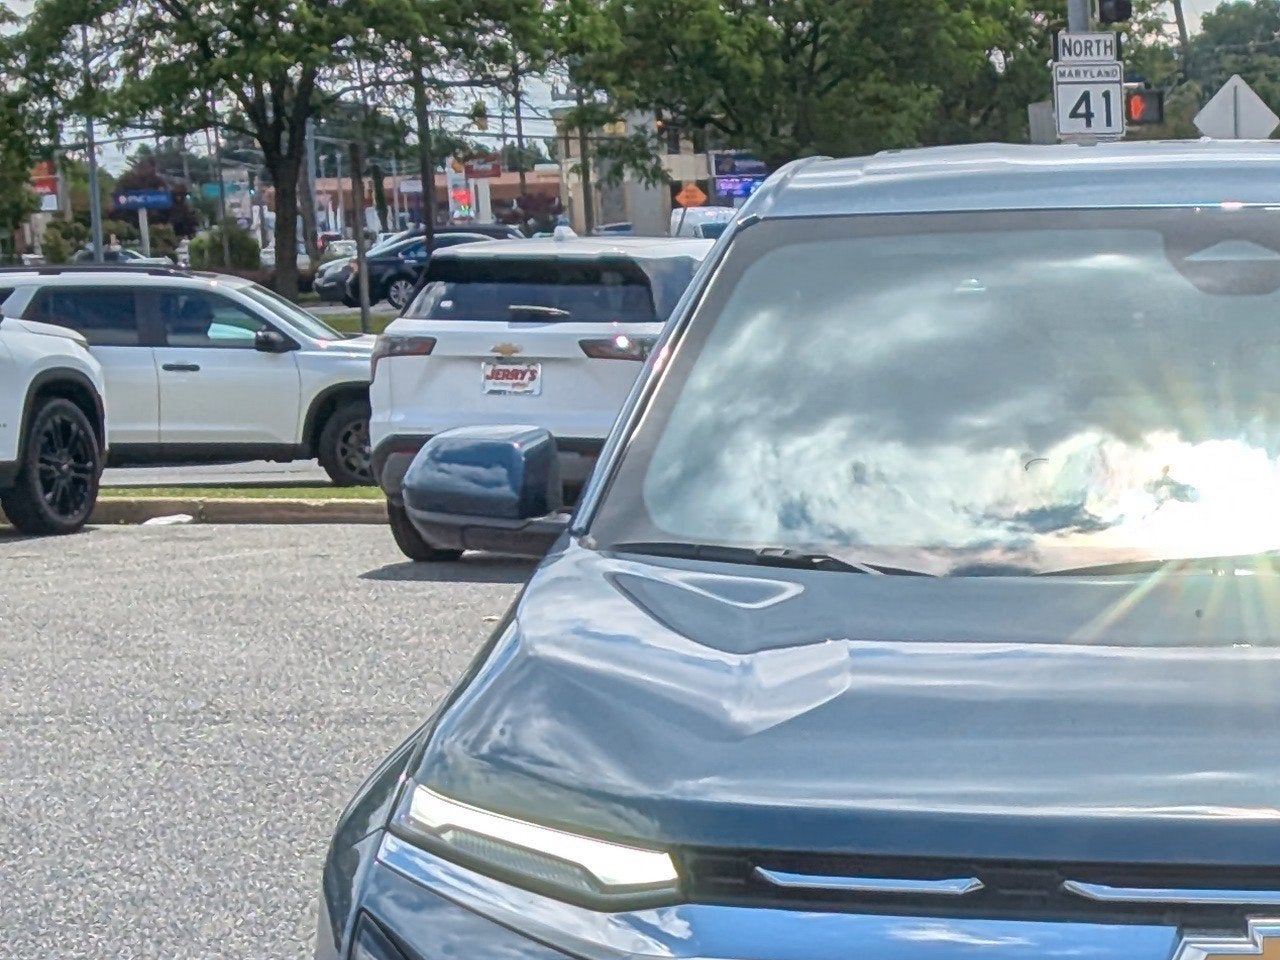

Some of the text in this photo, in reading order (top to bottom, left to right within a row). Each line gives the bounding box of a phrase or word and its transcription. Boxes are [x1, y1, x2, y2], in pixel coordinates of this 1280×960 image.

[1062, 39, 1113, 57] NORTH
[1058, 69, 1118, 79] MARYLAND
[1068, 89, 1112, 128] 41
[485, 369, 538, 381] JERRY'S
